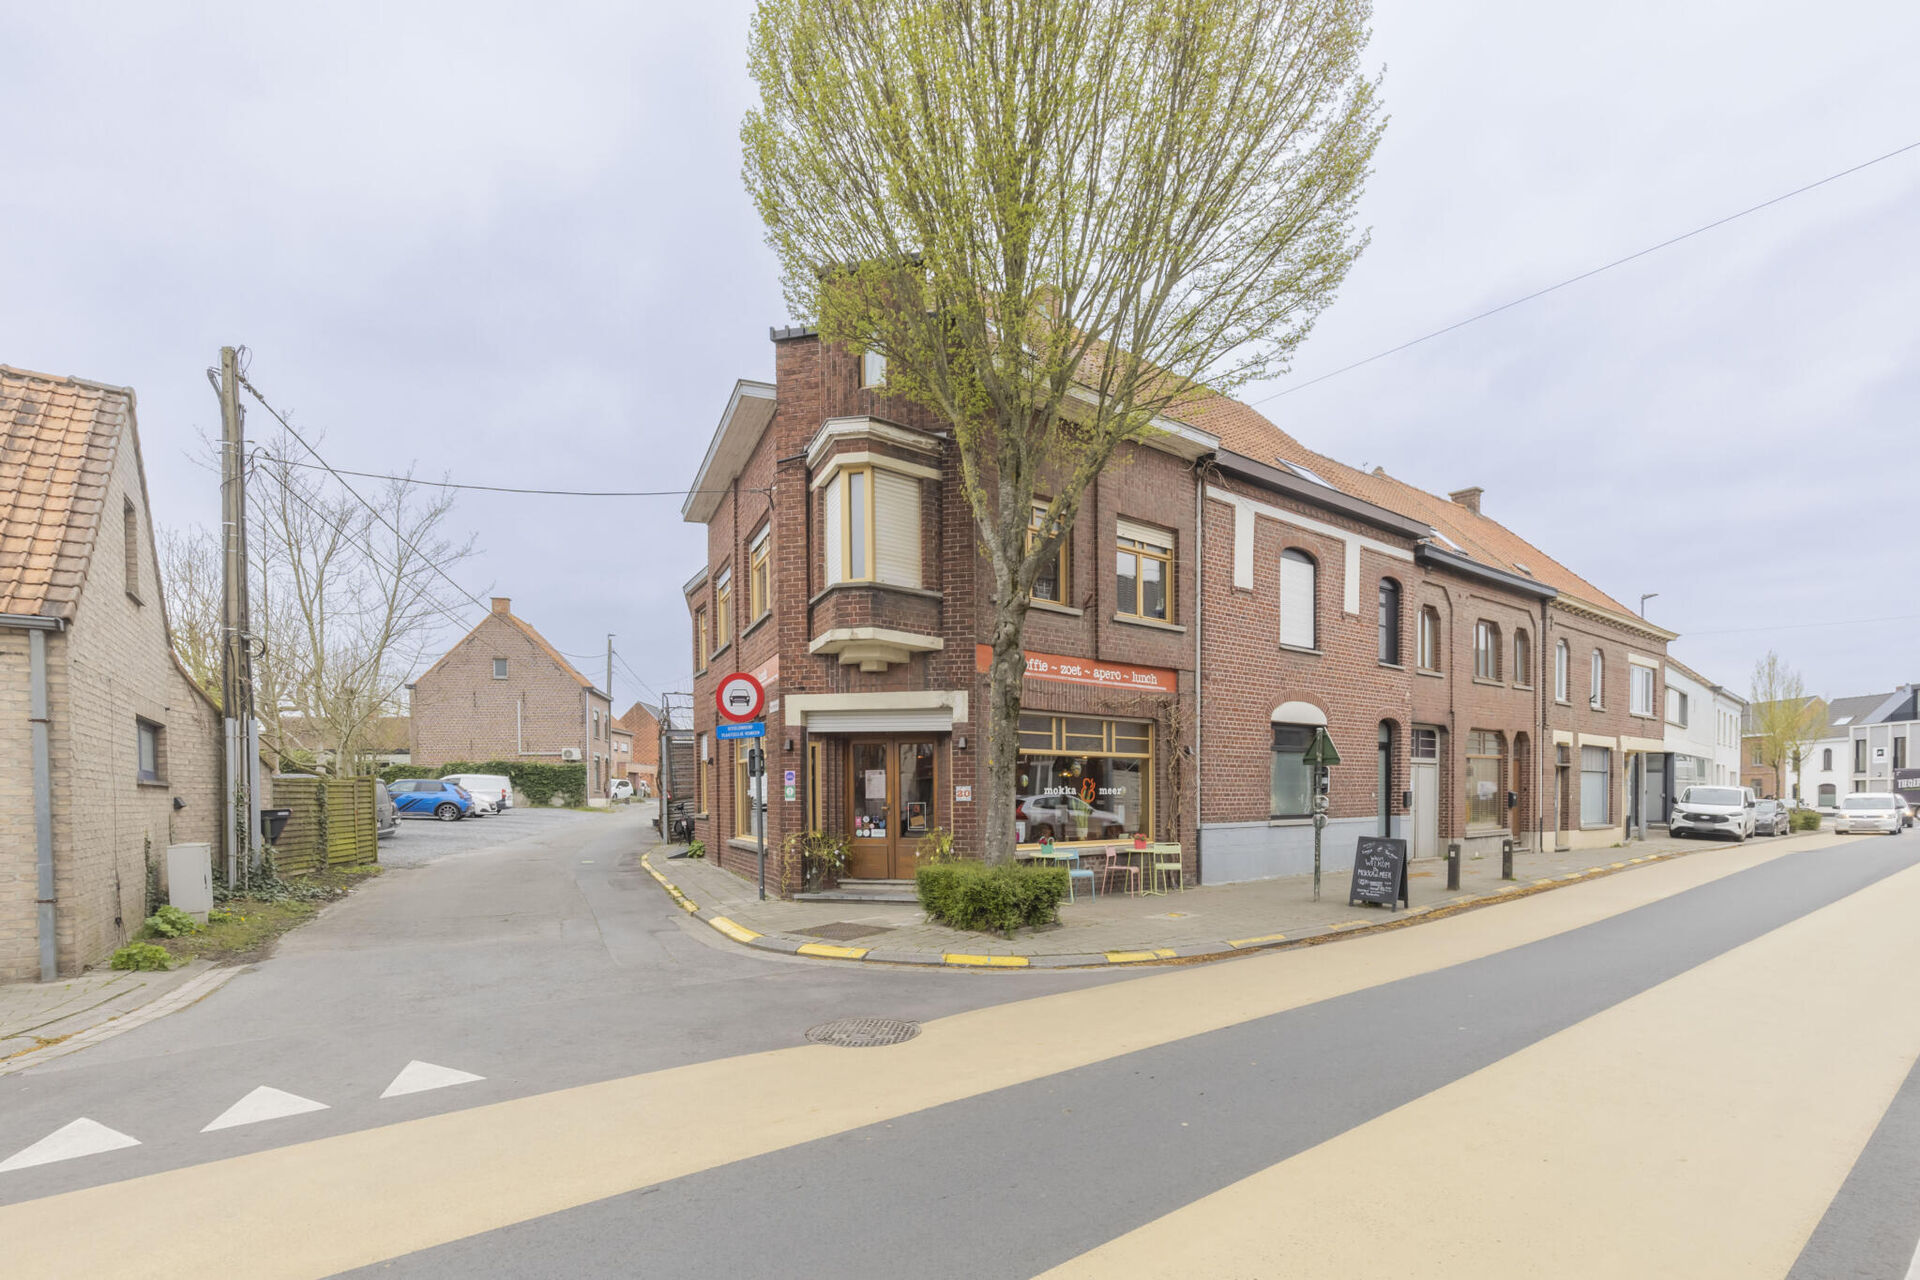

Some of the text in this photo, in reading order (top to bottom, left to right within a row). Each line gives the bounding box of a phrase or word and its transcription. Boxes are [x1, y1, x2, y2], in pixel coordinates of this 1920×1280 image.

[1060, 664, 1082, 676] zoet
[1093, 668, 1121, 681] apero
[1132, 671, 1158, 685] lunch
[1044, 785, 1077, 795] mokka
[1099, 786, 1122, 795] meer
